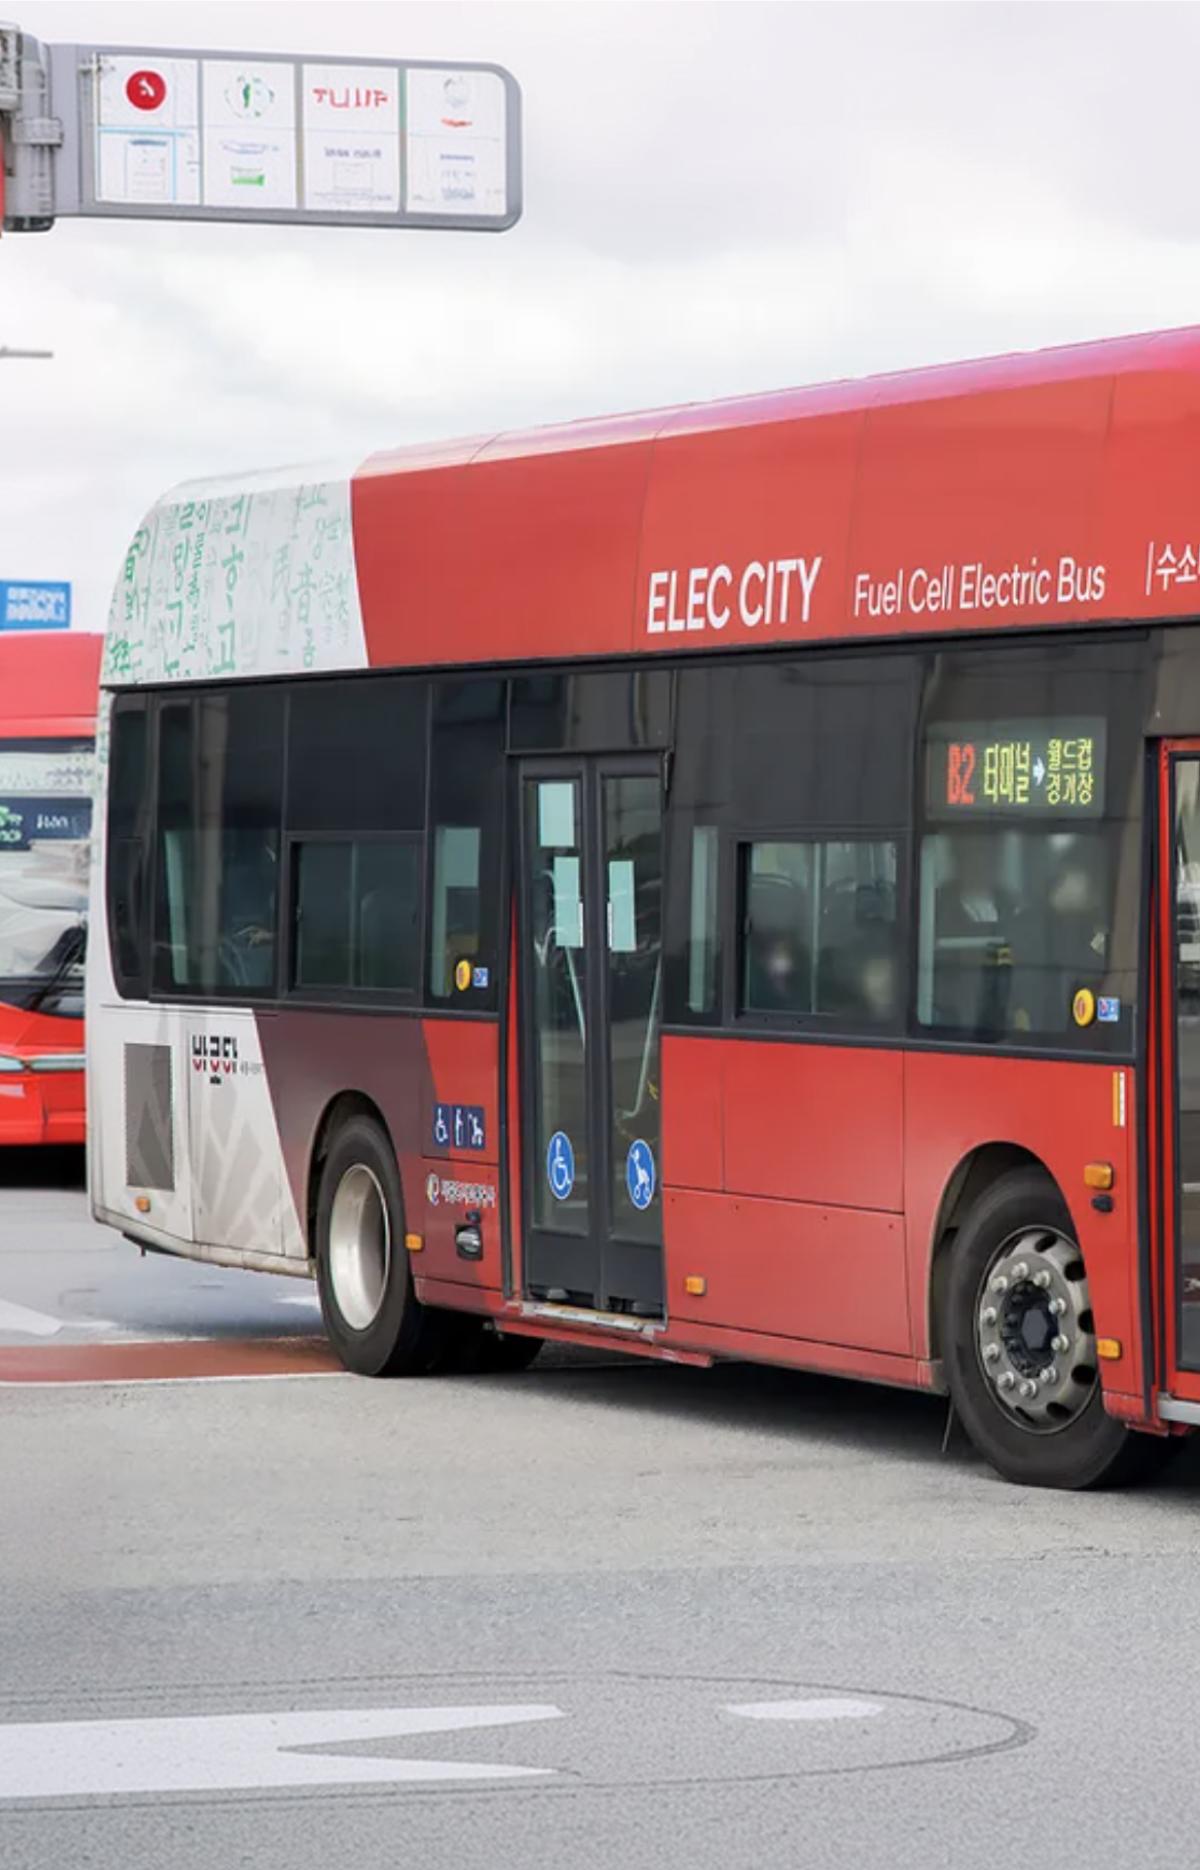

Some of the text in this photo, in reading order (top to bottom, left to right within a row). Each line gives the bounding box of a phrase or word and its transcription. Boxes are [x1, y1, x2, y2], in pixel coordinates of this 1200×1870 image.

[646, 556, 823, 634] ELEC CITY
[853, 556, 1106, 617] Fuel Cell Electric Bus
[946, 743, 976, 805] B2
[982, 742, 1031, 804] 터미널
[1046, 737, 1094, 771] 월드컵
[1046, 771, 1095, 806] 경기장
